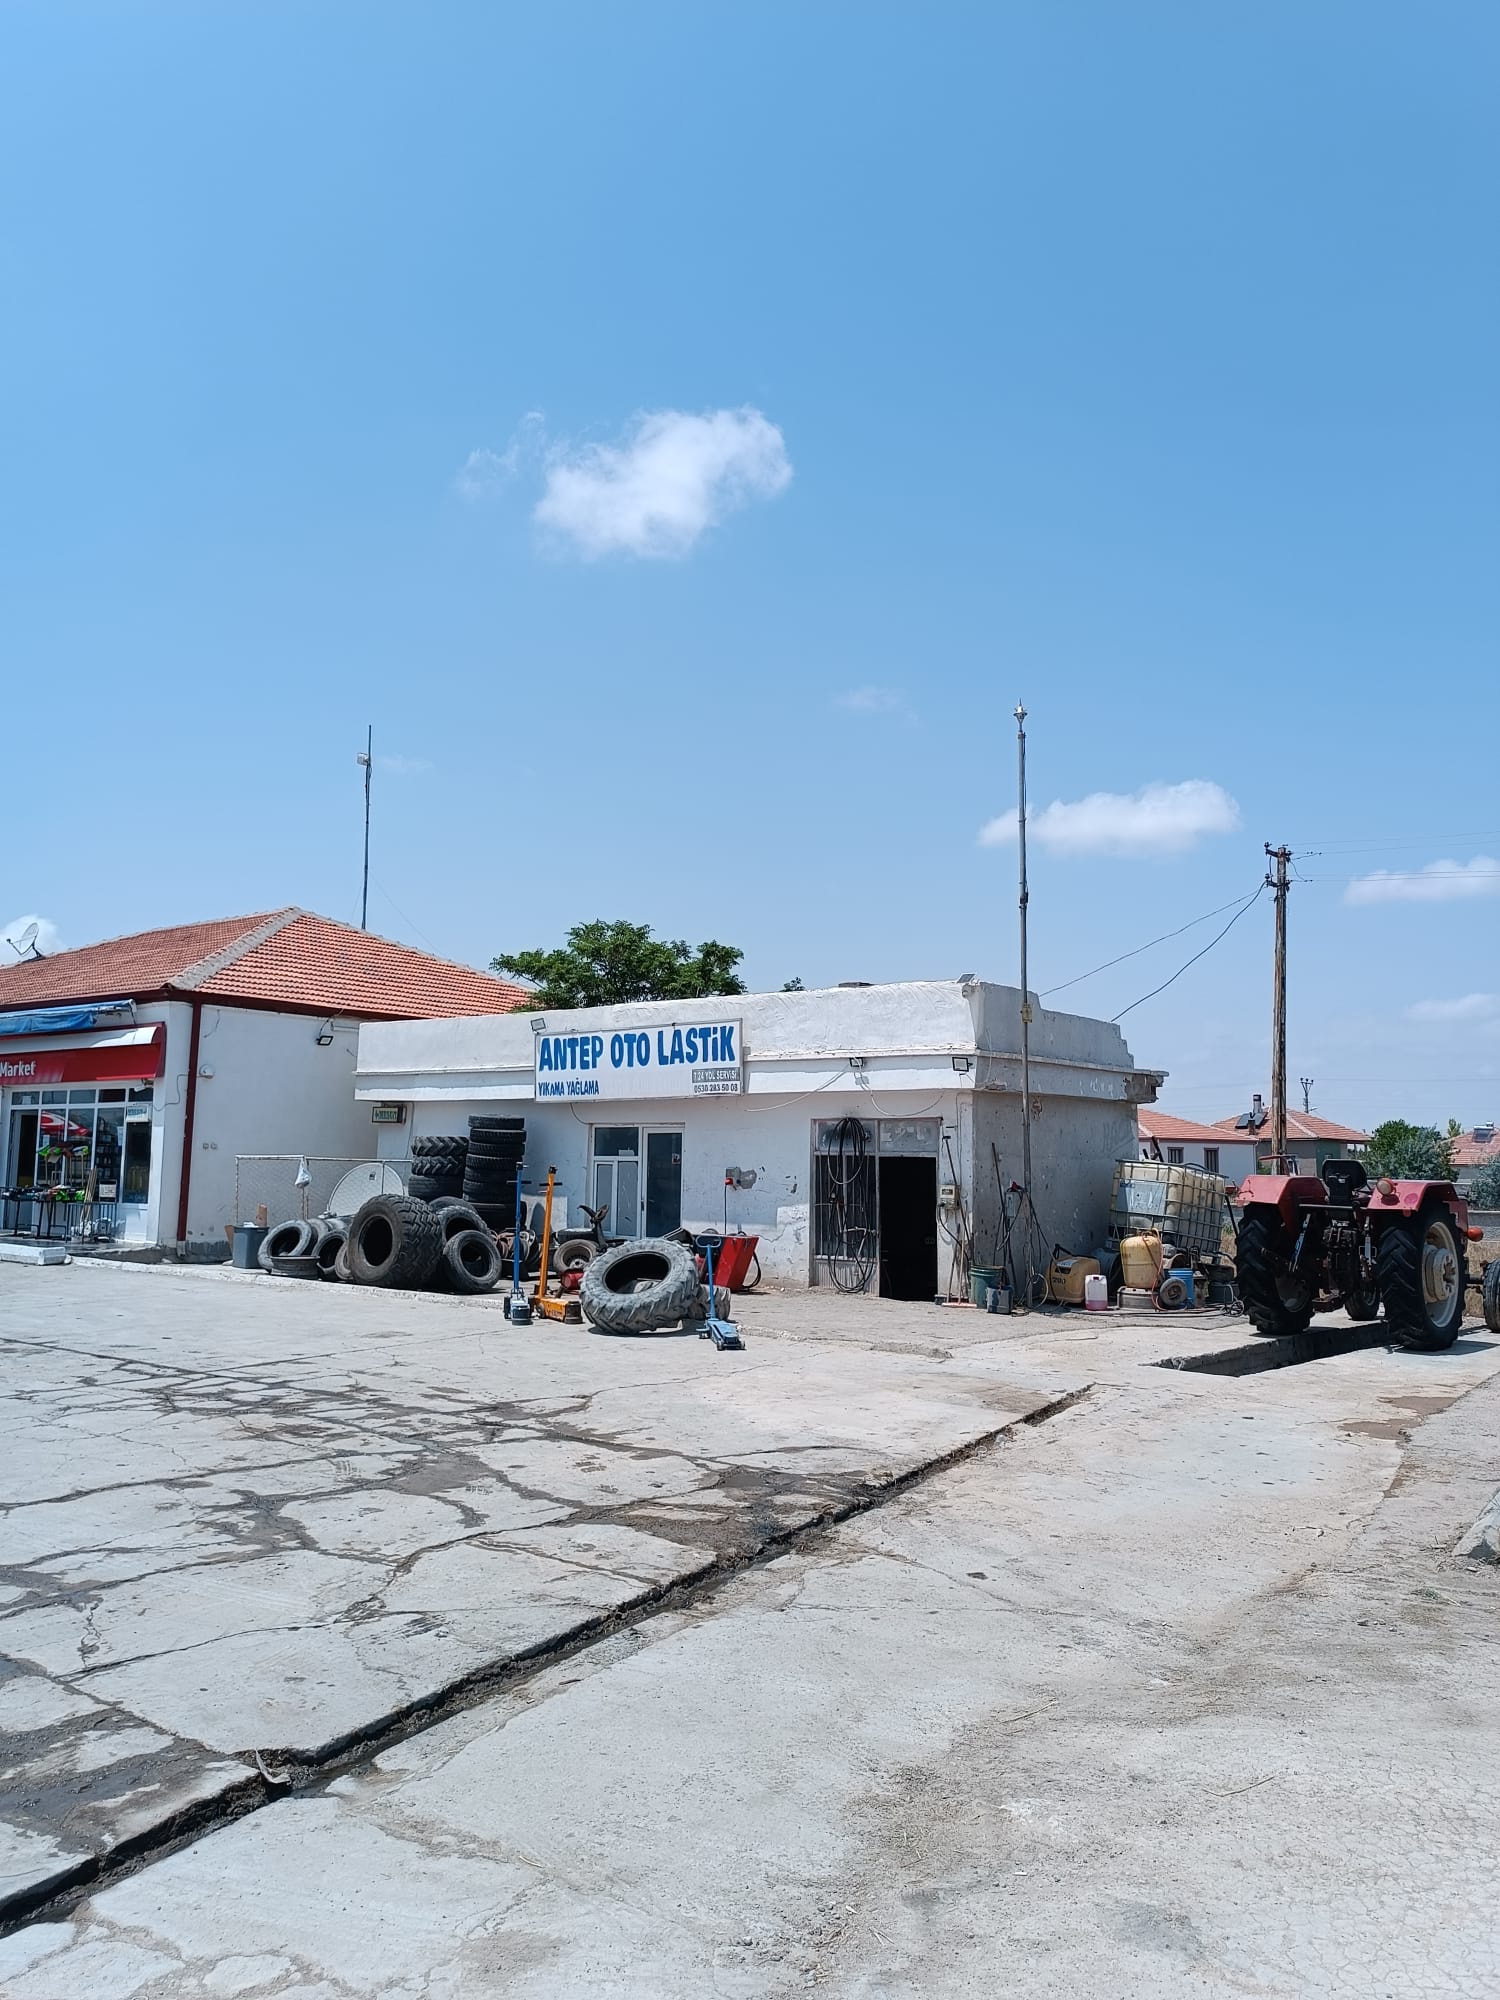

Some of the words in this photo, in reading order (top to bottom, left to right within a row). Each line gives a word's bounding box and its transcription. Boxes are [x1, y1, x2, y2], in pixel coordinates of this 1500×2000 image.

[539, 1036, 604, 1072] ANTEP
[610, 1032, 651, 1069] OTO
[0, 1060, 37, 1077] Market
[538, 1081, 565, 1097] YIKAMA
[566, 1076, 600, 1096] YAĞLAMA
